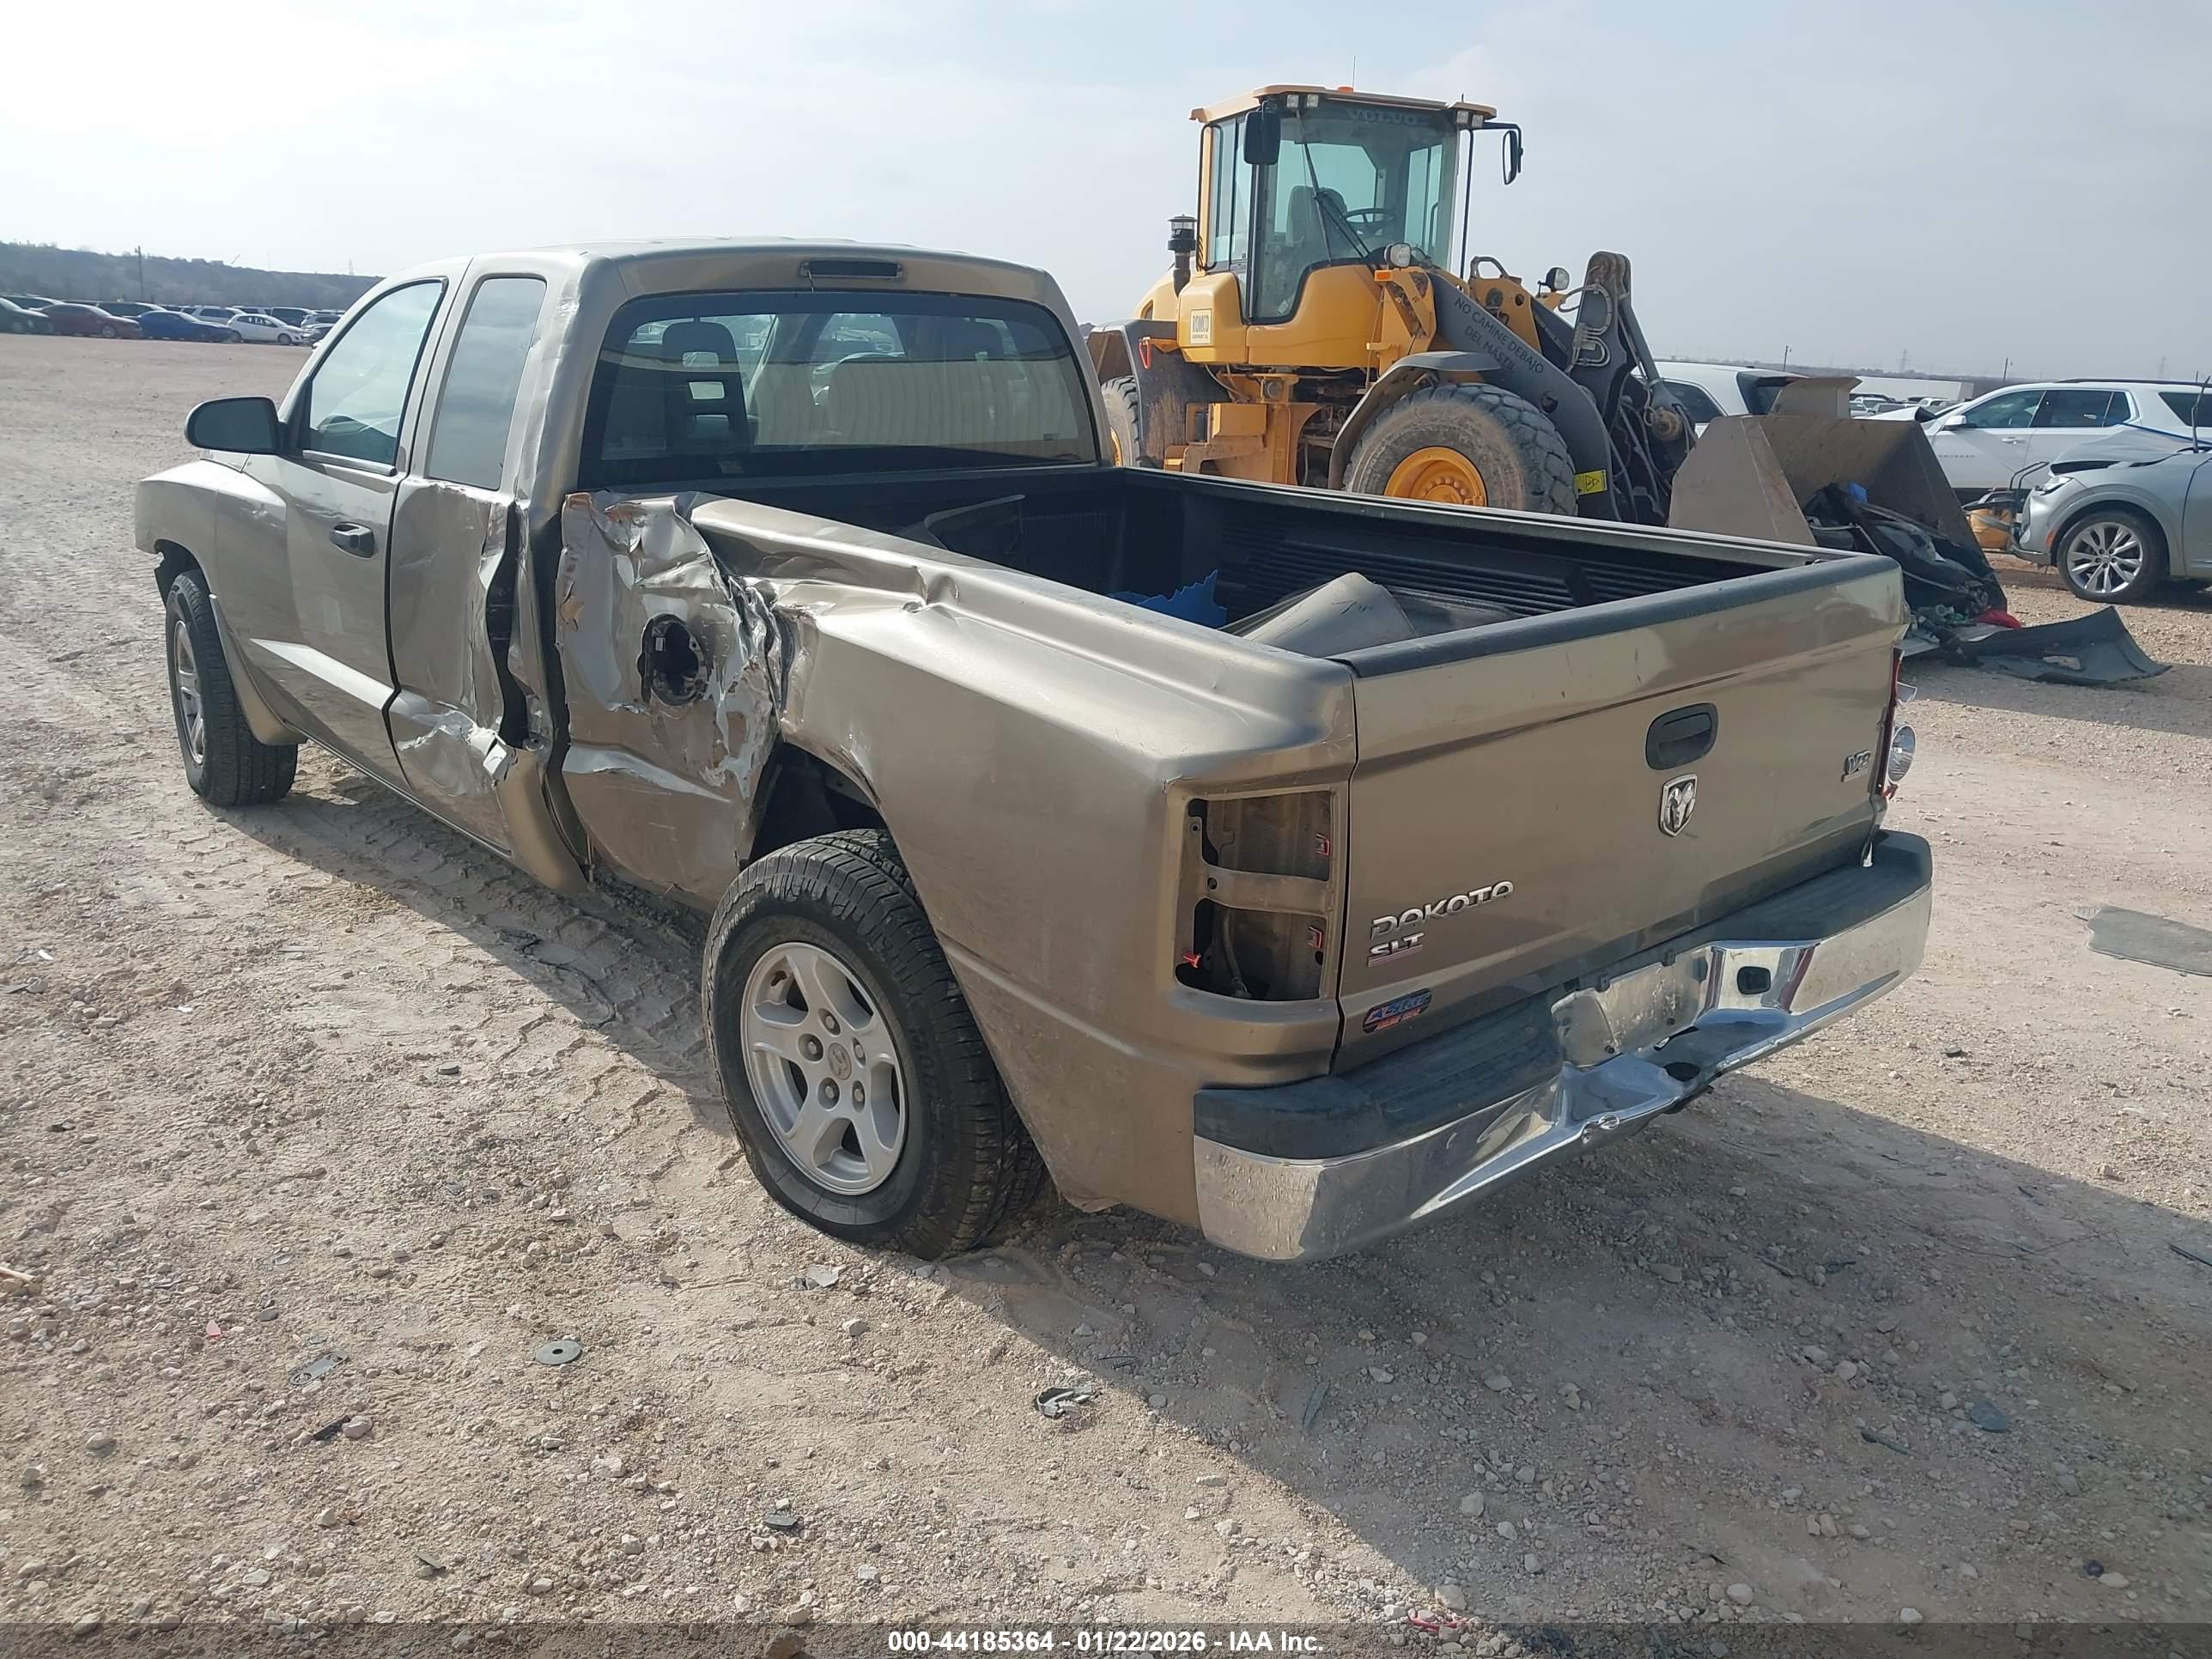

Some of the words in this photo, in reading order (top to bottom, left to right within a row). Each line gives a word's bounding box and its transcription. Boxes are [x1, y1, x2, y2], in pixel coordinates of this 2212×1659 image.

[1345, 108, 1418, 126] VOLVO
[1455, 298, 1471, 314] NO
[1472, 312, 1508, 345] CAMINE
[1508, 341, 1545, 374] DEBAJO
[1465, 325, 1482, 344] DEL
[1370, 880, 1515, 941] DAKOTA
[1369, 932, 1425, 958] SLT
